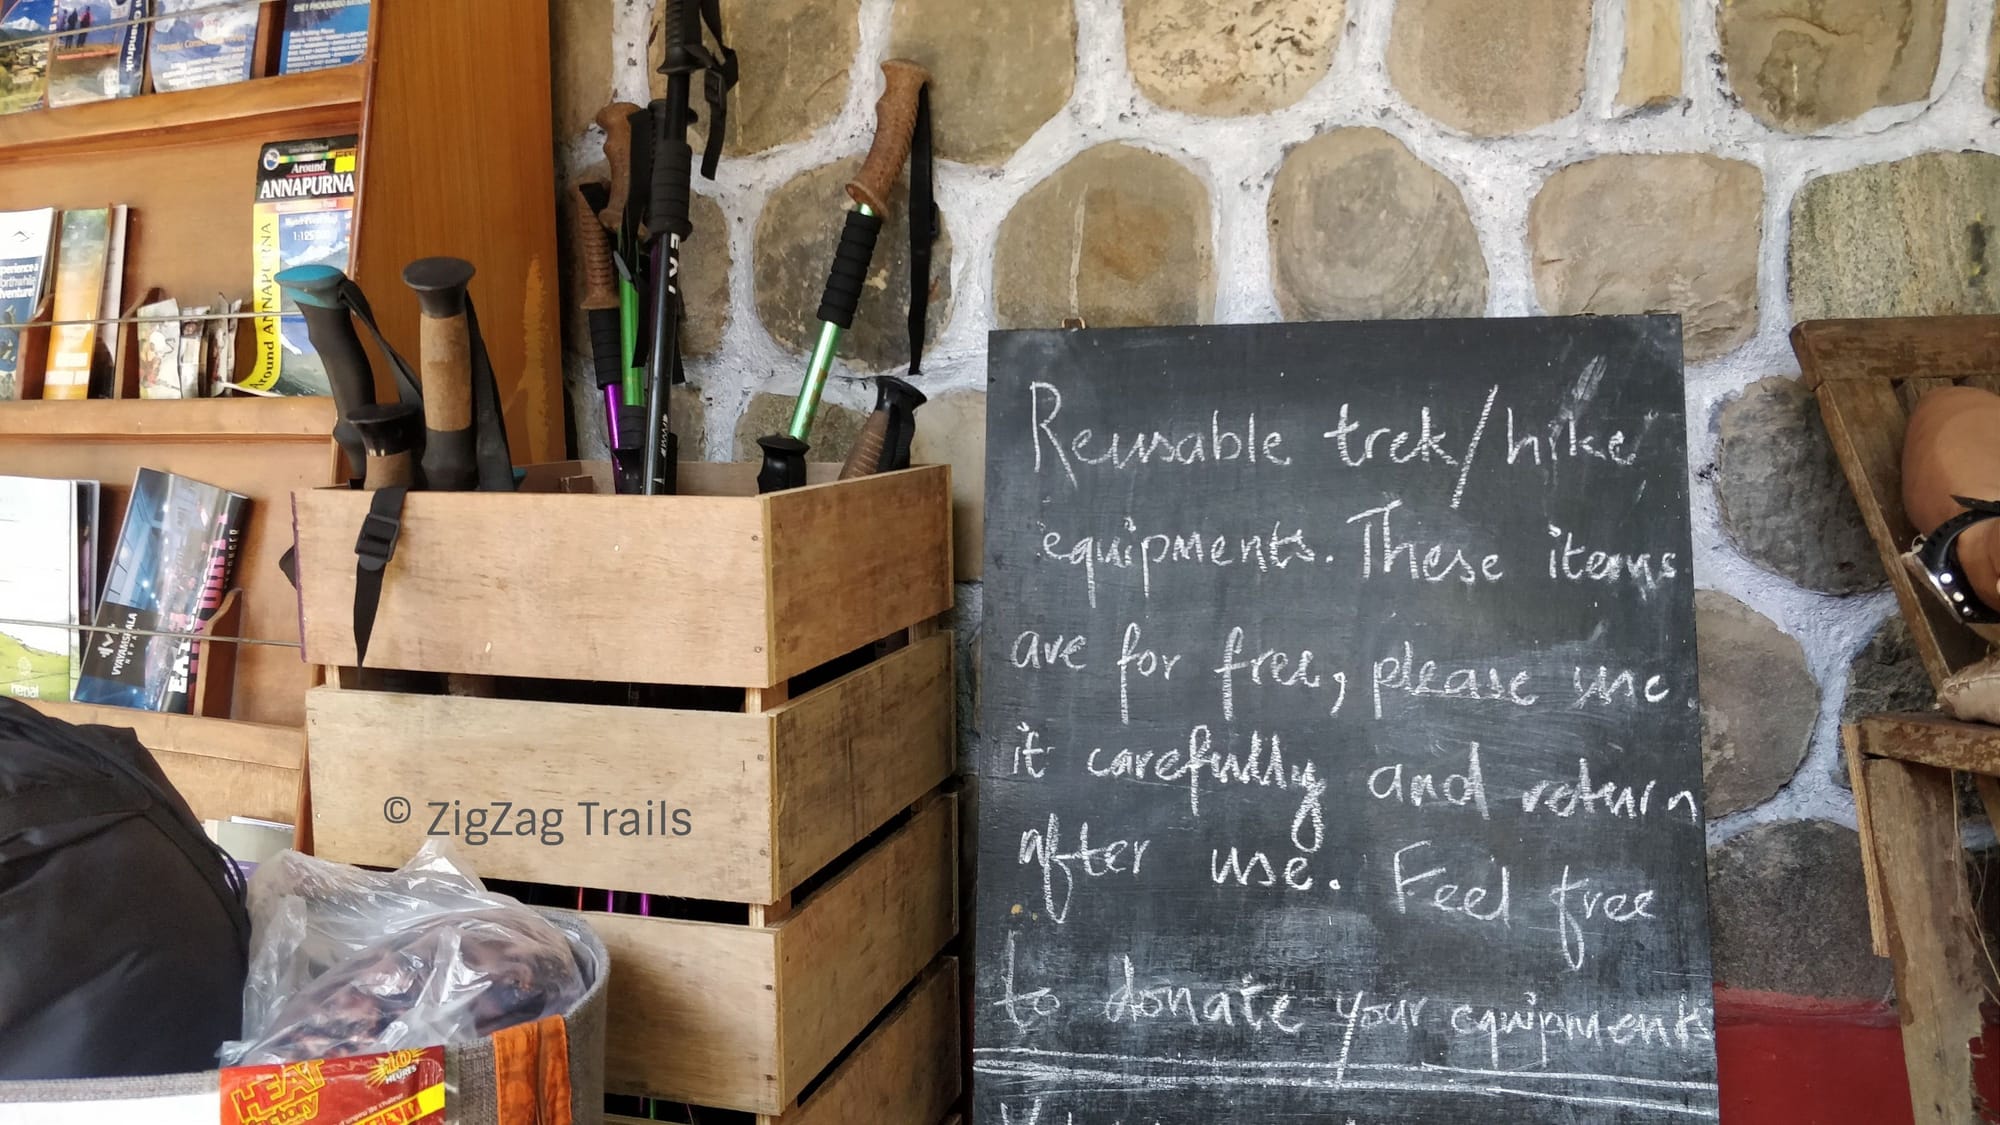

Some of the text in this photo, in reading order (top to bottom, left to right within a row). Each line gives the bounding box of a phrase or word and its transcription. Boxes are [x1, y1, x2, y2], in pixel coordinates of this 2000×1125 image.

[260, 173, 355, 199] ANNAPURNA
[291, 160, 328, 174] Around
[249, 341, 275, 391] Around
[1030, 381, 1293, 488] Reusable
[1043, 499, 1676, 608] equipments. These items
[124, 629, 140, 665] NEPA
[1011, 631, 1087, 670] are
[1117, 622, 1182, 724] for
[1214, 626, 1347, 720] free,
[1373, 641, 1540, 720] please
[1012, 721, 1050, 778] it
[1087, 725, 1326, 852] carefully
[1368, 741, 1490, 820] and
[1019, 813, 1657, 971] after use. Feel free
[994, 930, 1061, 1034] to
[1104, 954, 1304, 1034] donate
[1336, 990, 1427, 1090] your
[231, 1059, 326, 1123] HEAT
[386, 1064, 417, 1085] HEURES
